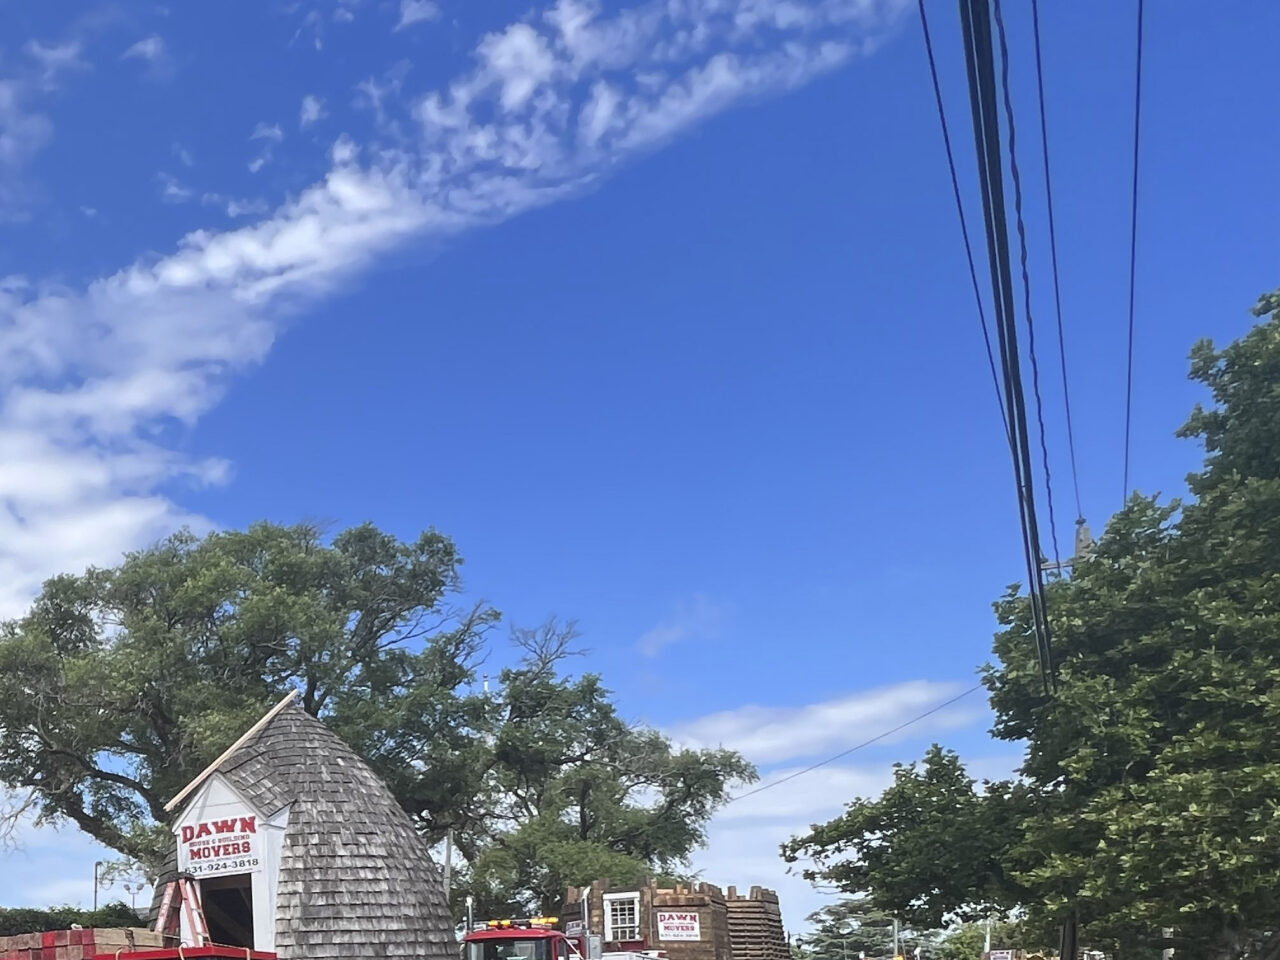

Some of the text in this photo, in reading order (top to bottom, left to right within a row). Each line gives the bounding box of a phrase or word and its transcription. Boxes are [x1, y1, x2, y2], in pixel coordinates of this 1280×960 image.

[181, 816, 256, 844] DAWN
[190, 841, 251, 860] MOVERS
[185, 858, 259, 874] 631-924-3818
[659, 914, 697, 922] DAWN
